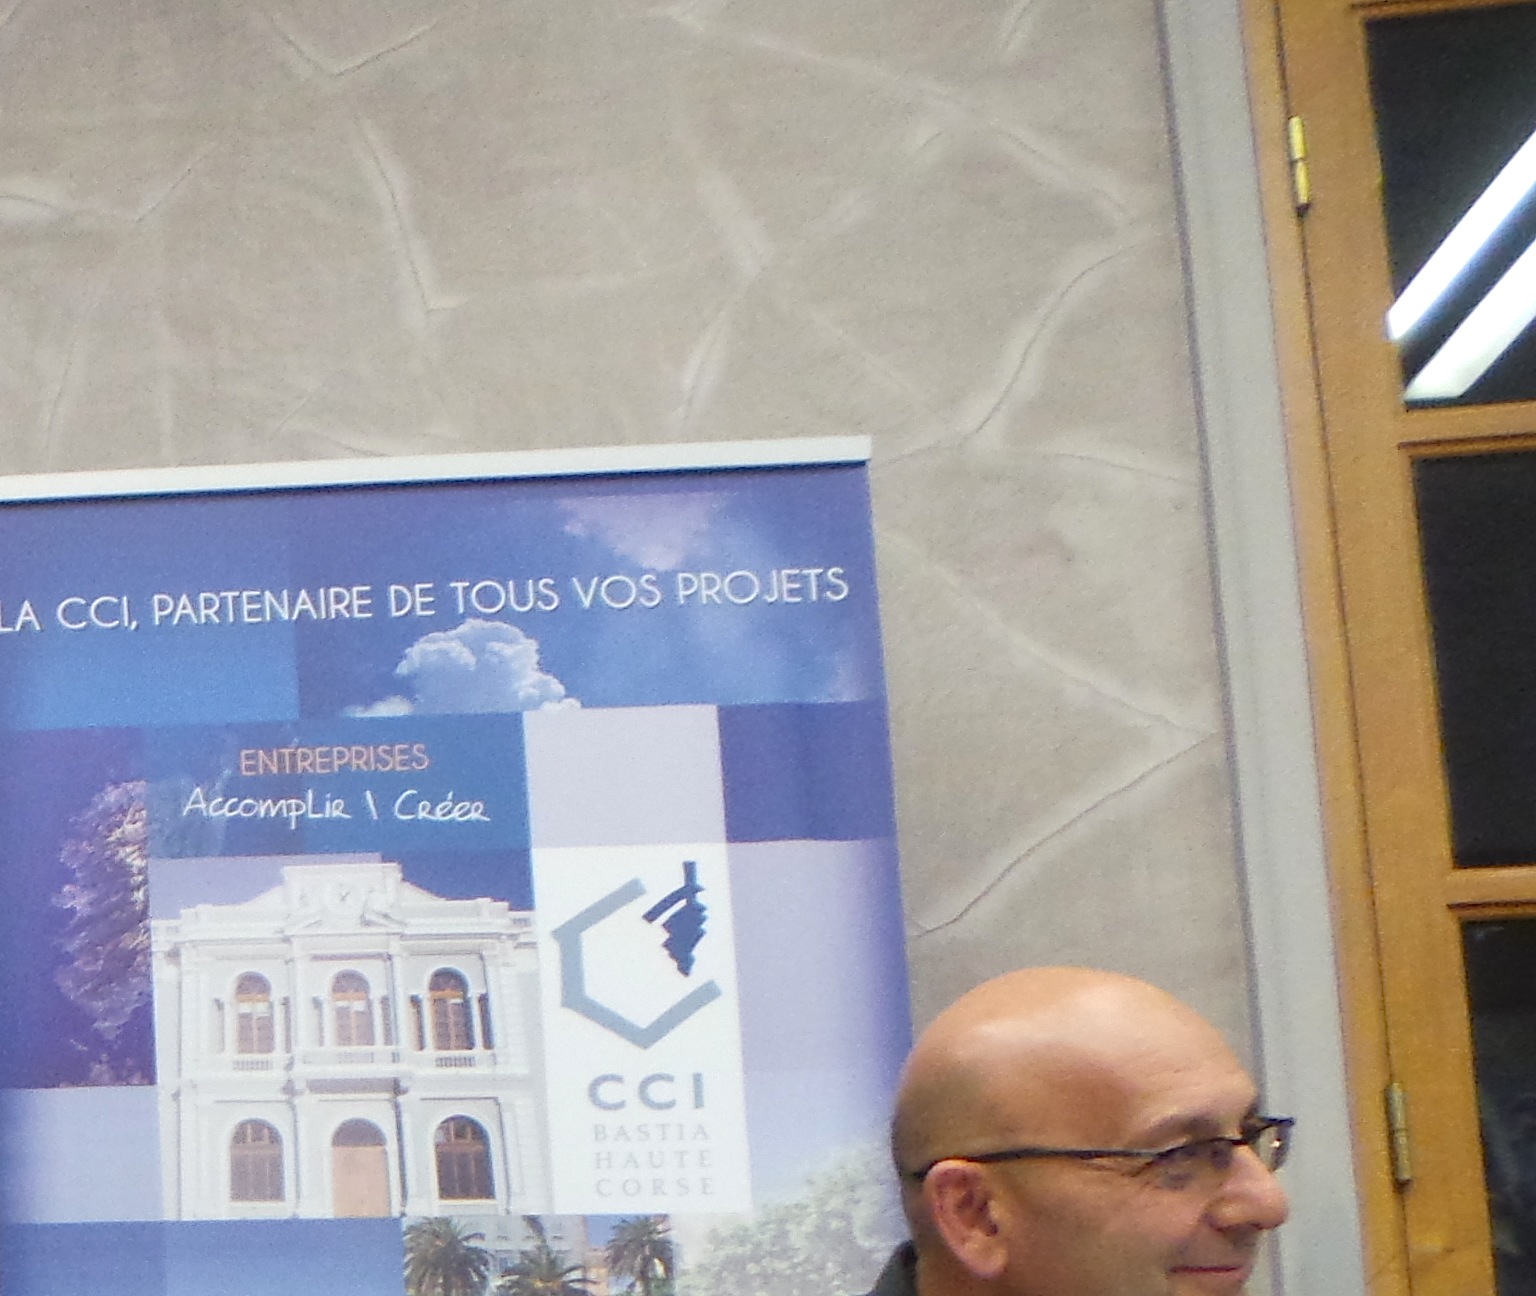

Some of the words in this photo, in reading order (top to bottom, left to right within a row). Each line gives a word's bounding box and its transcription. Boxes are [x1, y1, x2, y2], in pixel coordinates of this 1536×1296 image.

[57, 596, 138, 630] CCI,
[152, 586, 372, 626] PARTENAIRE
[390, 583, 435, 618] DE
[450, 577, 560, 615] TOUS
[572, 573, 660, 608] VOS
[677, 566, 849, 605] PROJETS
[240, 744, 429, 776] ENTREPRISES
[394, 790, 490, 822] Créer
[587, 1072, 706, 1112] CCI
[594, 1122, 711, 1141] BASTIA
[596, 1149, 714, 1169] HAUTE
[596, 1177, 714, 1196] CORSE
